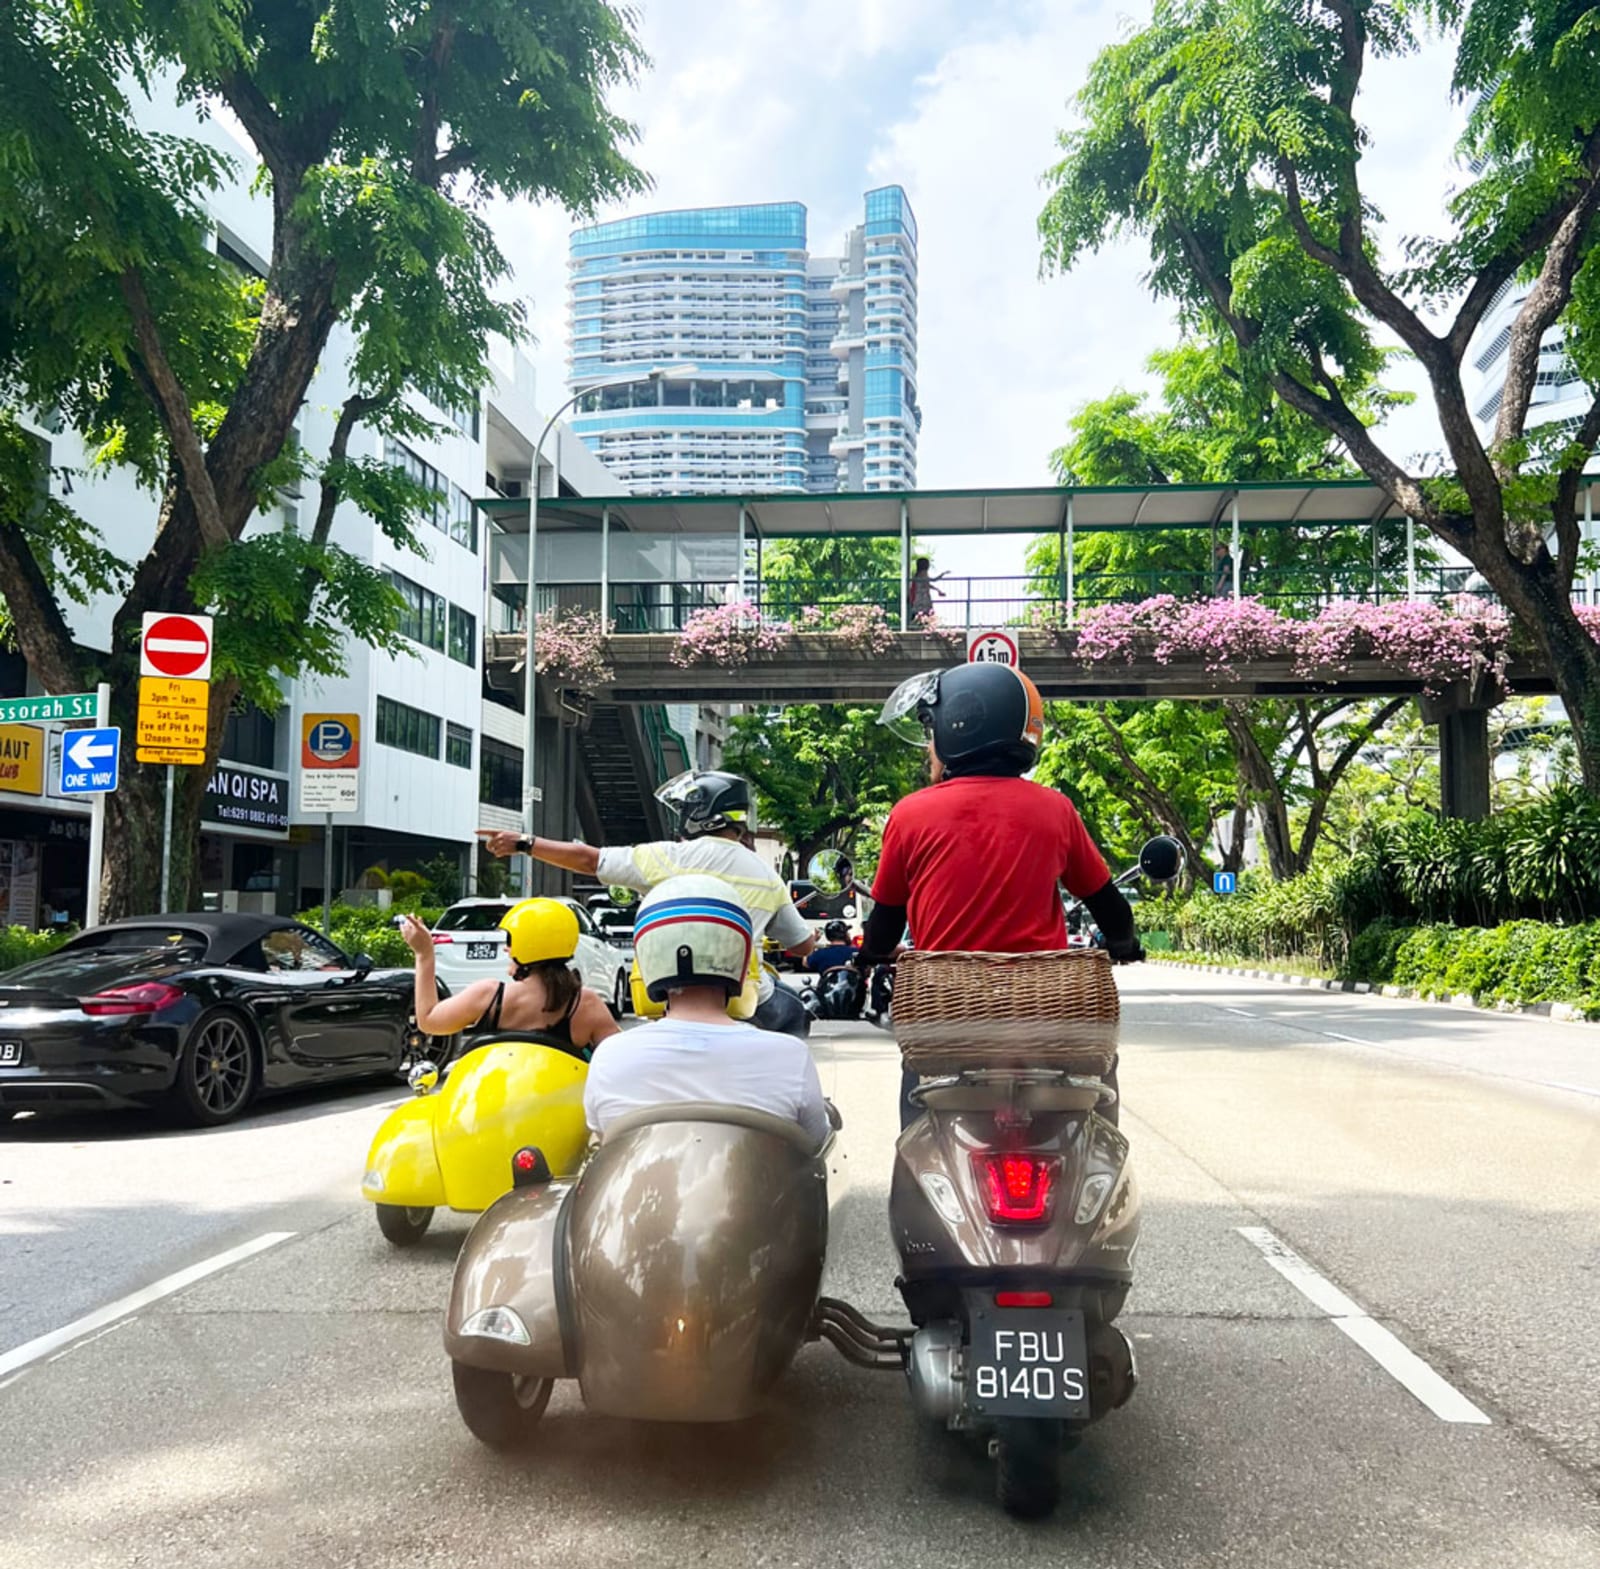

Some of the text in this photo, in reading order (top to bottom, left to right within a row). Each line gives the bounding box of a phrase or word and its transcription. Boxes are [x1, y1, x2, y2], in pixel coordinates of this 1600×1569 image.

[977, 648, 1009, 664] 45m
[169, 682, 180, 692] Fri
[72, 698, 92, 716] St
[174, 711, 190, 721] Sun
[140, 721, 205, 733] Eve of PH & PH
[0, 738, 30, 761] AUT
[0, 763, 20, 780] LUB
[65, 772, 113, 787] ONE WAY
[206, 772, 279, 804] AN QI SPA
[995, 1331, 1064, 1363] FBU
[976, 1366, 1055, 1400] 8140
